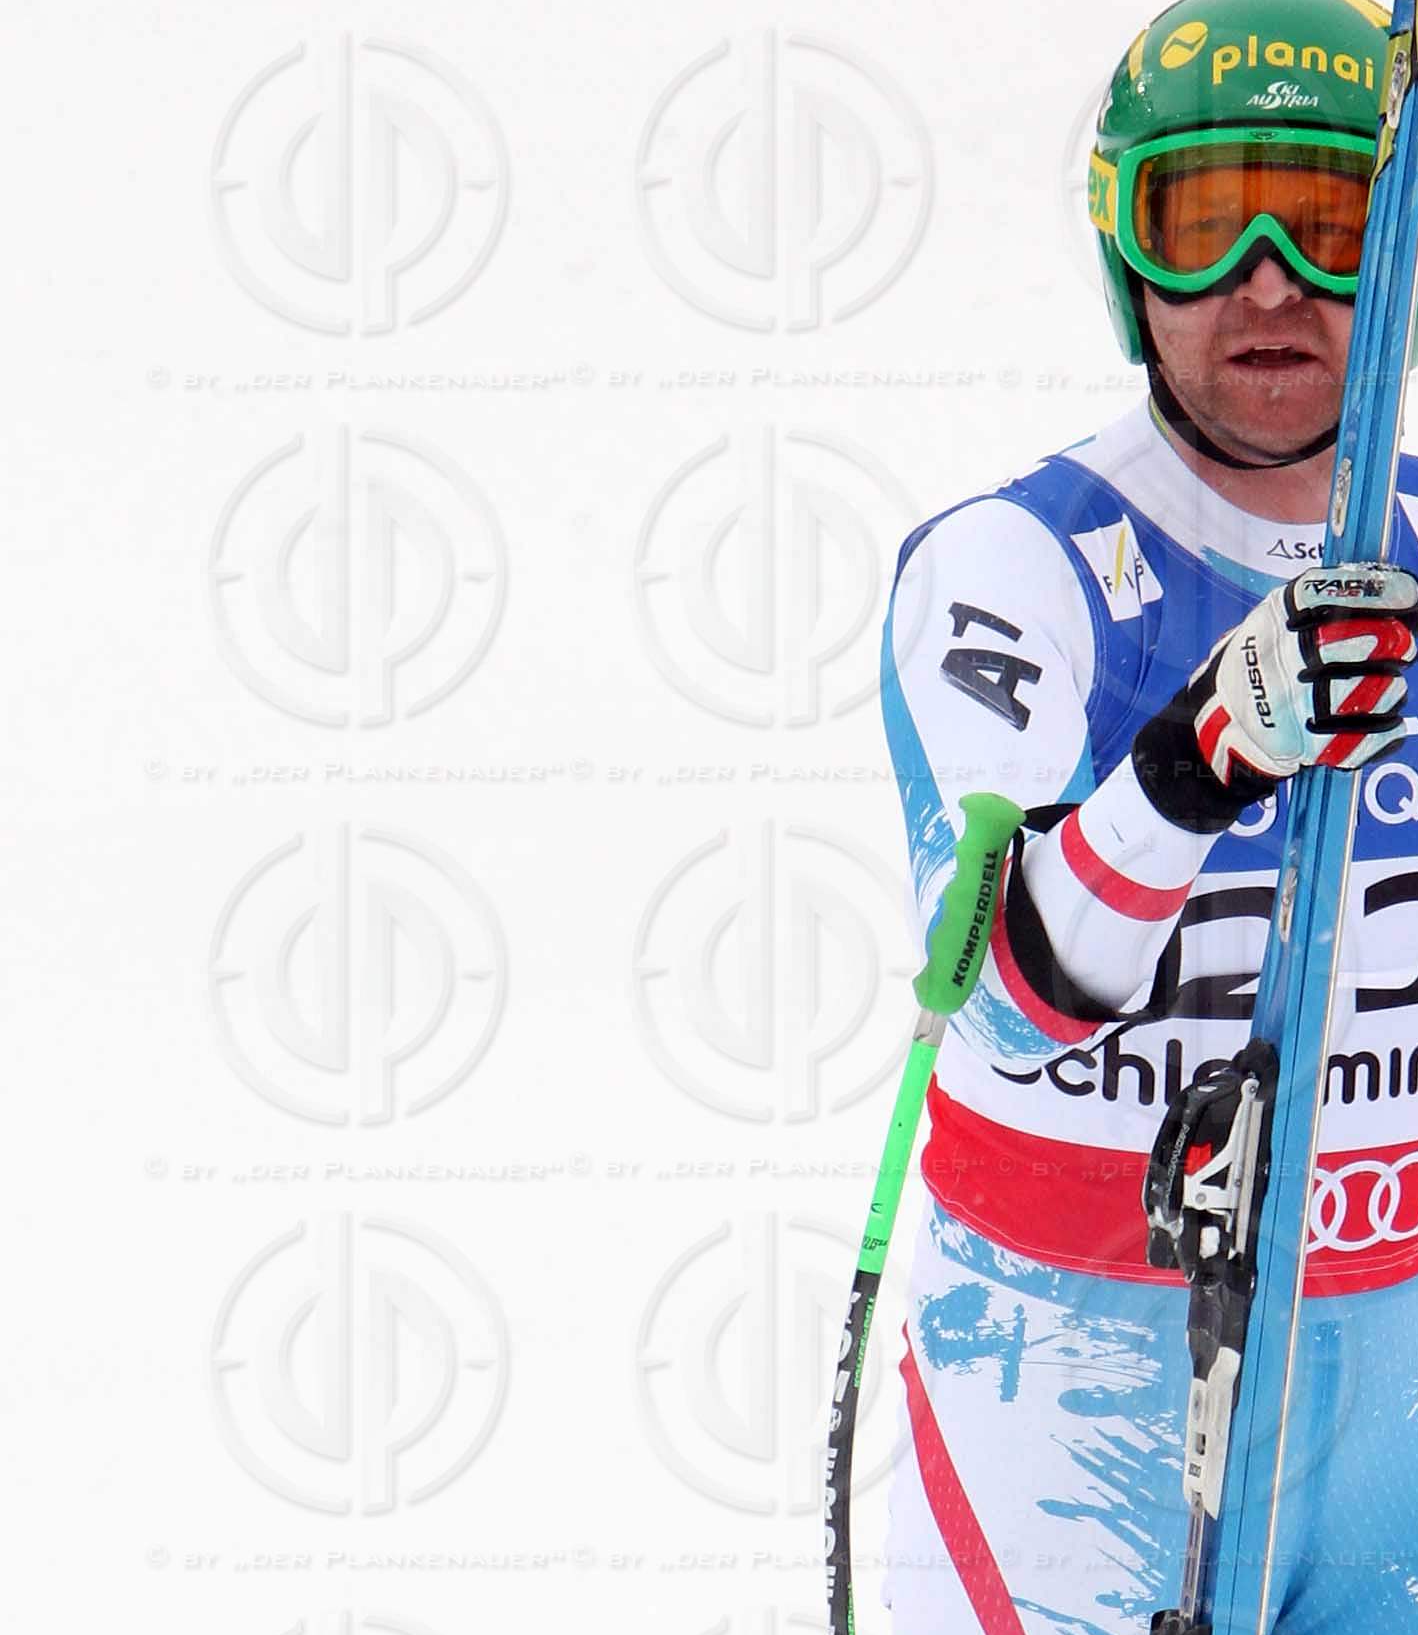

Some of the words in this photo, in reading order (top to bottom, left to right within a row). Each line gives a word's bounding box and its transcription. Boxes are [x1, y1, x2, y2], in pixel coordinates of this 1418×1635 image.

[1212, 35, 1374, 90] planai
[1240, 635, 1276, 729] reusch
[951, 849, 999, 988] KOMPERDELL
